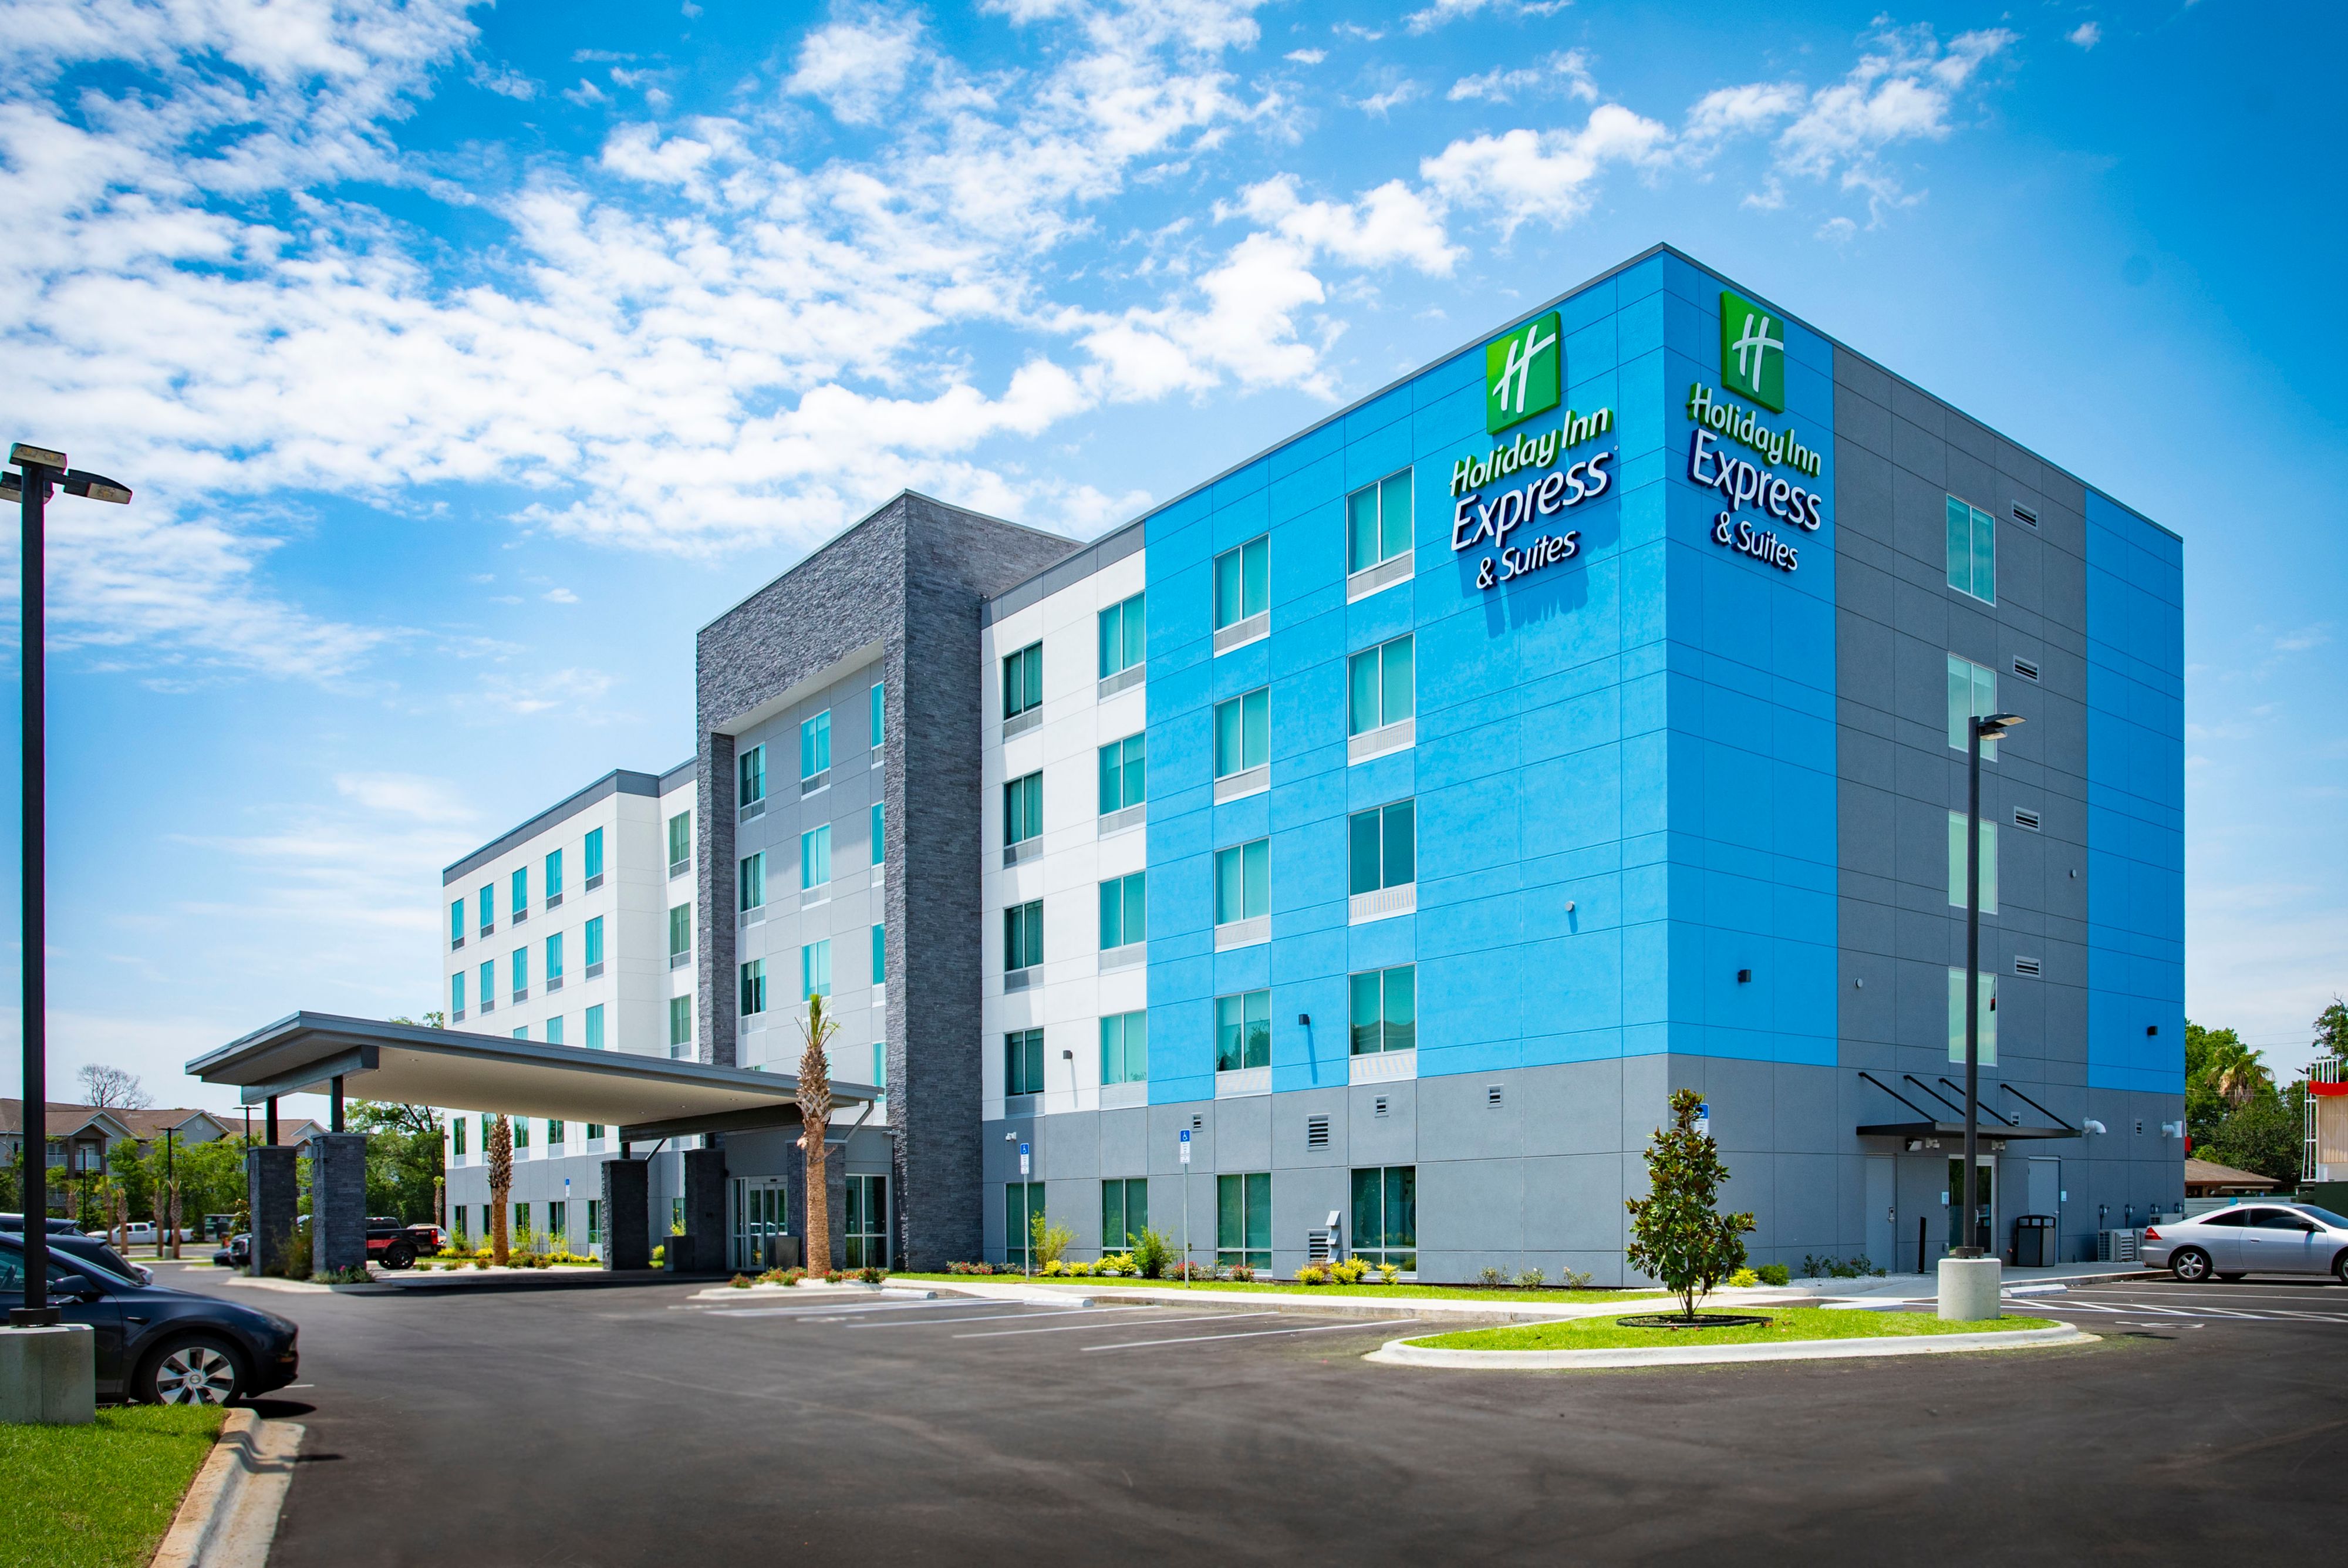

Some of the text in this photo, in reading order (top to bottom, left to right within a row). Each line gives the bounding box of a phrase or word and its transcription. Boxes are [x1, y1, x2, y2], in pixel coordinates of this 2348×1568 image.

[1449, 407, 1612, 497] Holiday Inn
[1686, 382, 1821, 477] Holiday Inn
[1450, 451, 1613, 552] Express
[1687, 427, 1822, 532] Express
[1475, 530, 1580, 590] & Suites
[1711, 511, 1799, 572] & Suites
